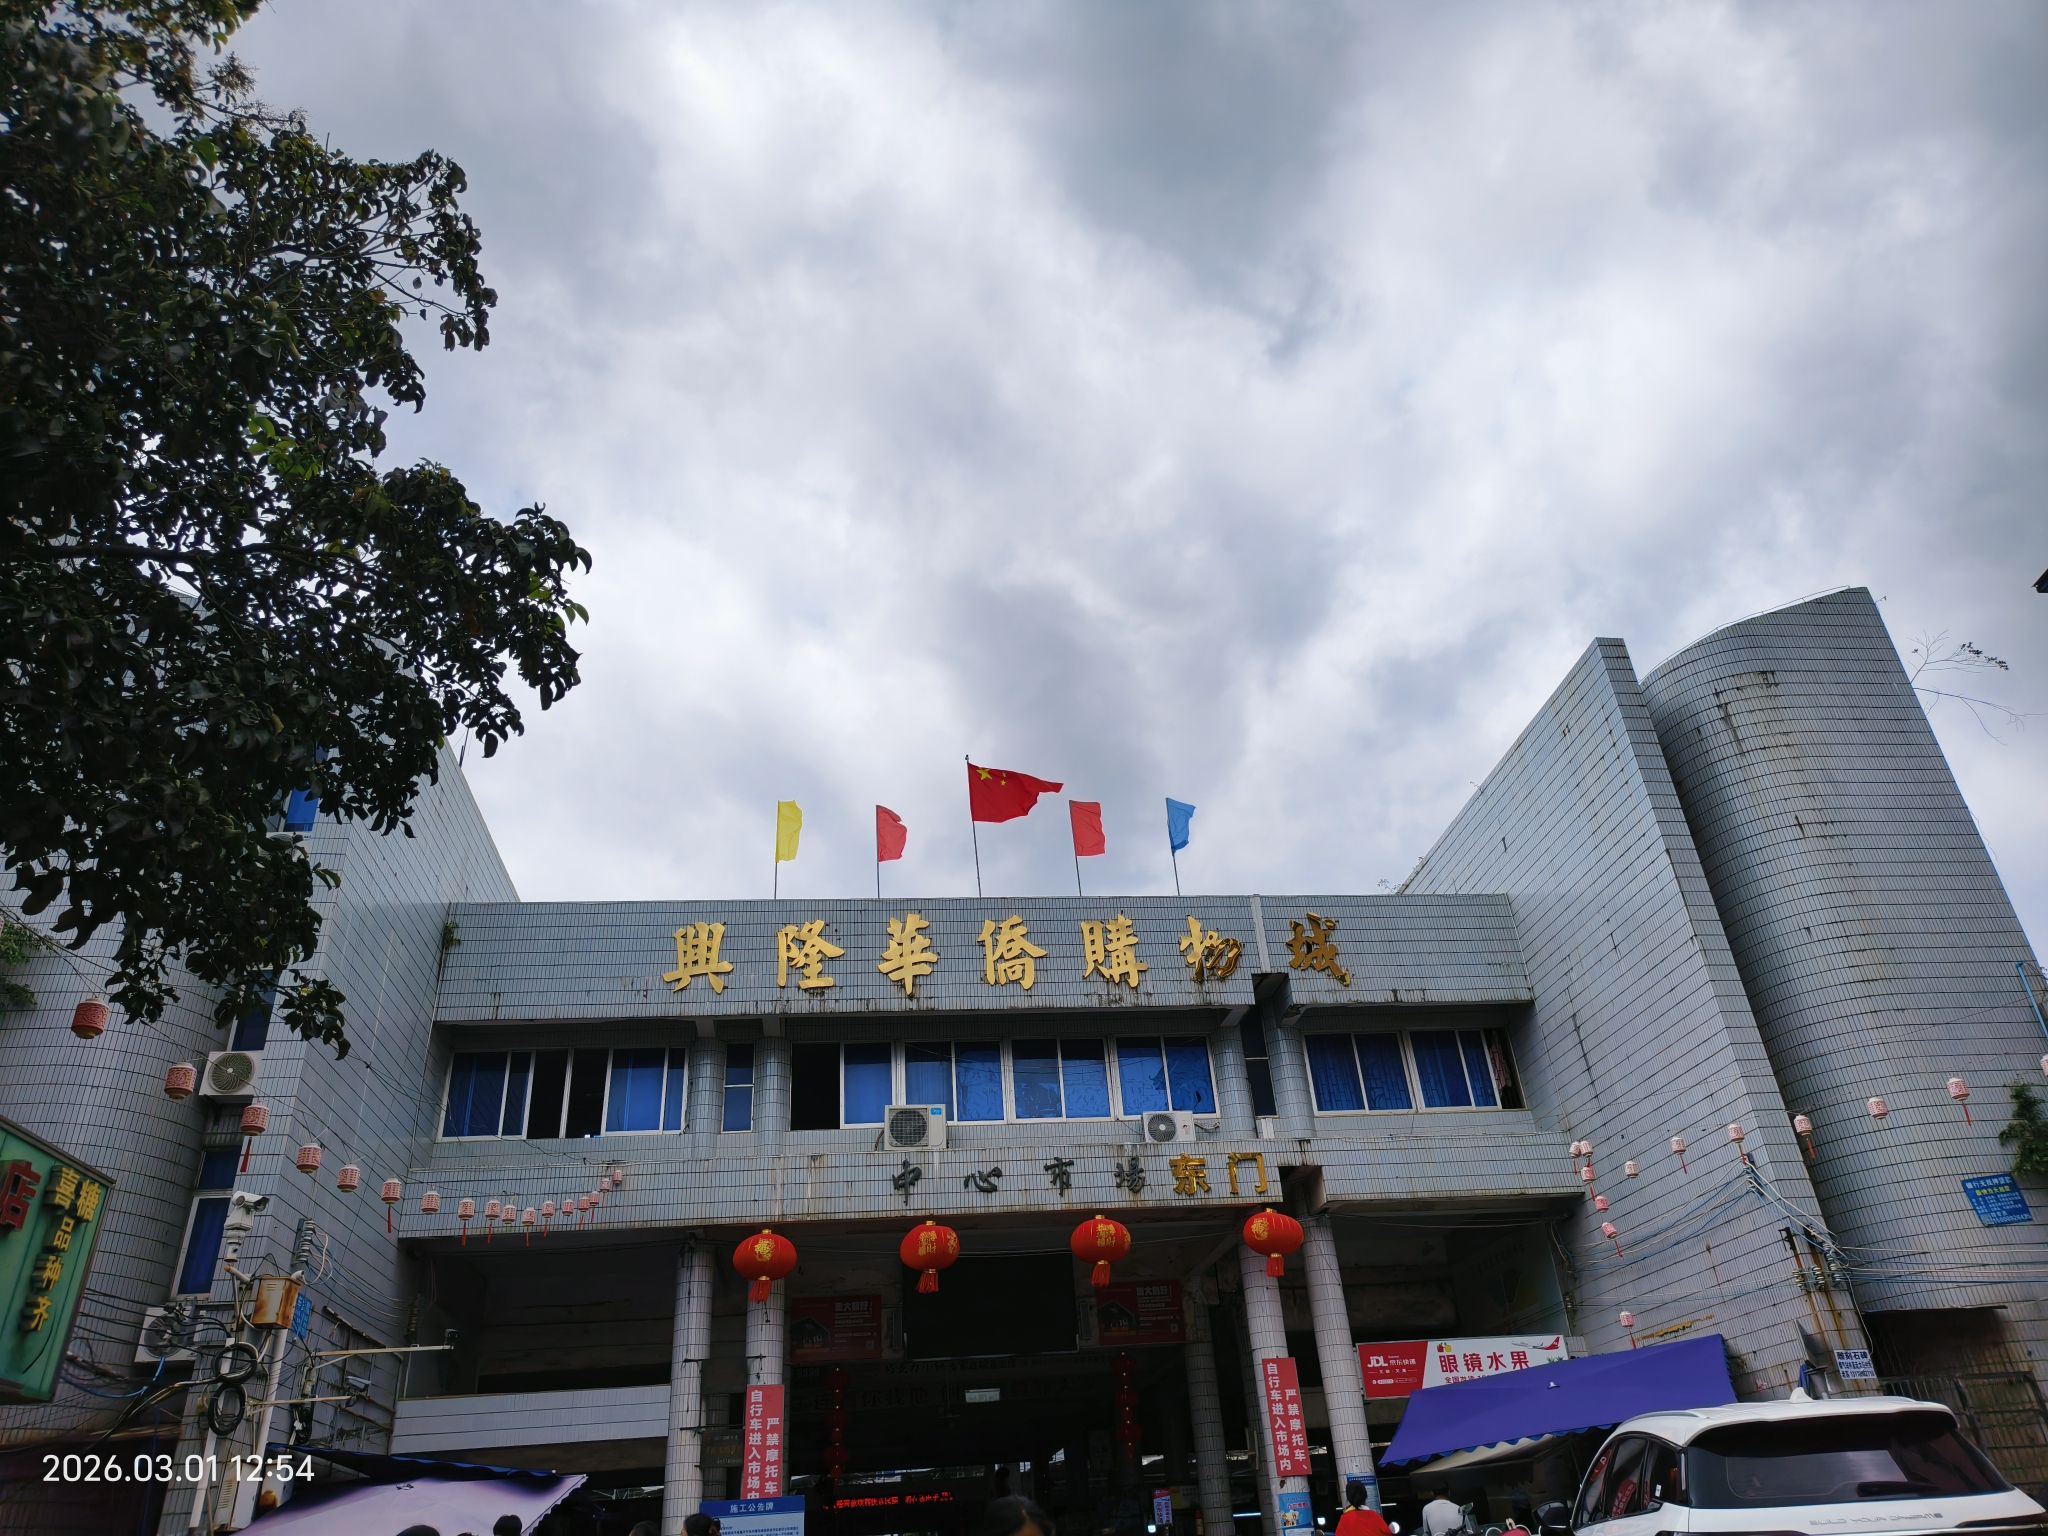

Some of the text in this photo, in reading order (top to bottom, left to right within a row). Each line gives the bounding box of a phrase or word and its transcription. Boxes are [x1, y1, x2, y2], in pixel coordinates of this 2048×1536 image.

[662, 912, 1351, 996] 興隆華僑購物城
[0, 1162, 42, 1231] 店
[1367, 1355, 1388, 1368] JDL
[1438, 1350, 1530, 1374] 眼镜水果
[1267, 1362, 1292, 1471] 自行车进入市场内
[764, 1417, 780, 1495] 严禁摩托车
[730, 1502, 774, 1514] 施工公告牌
